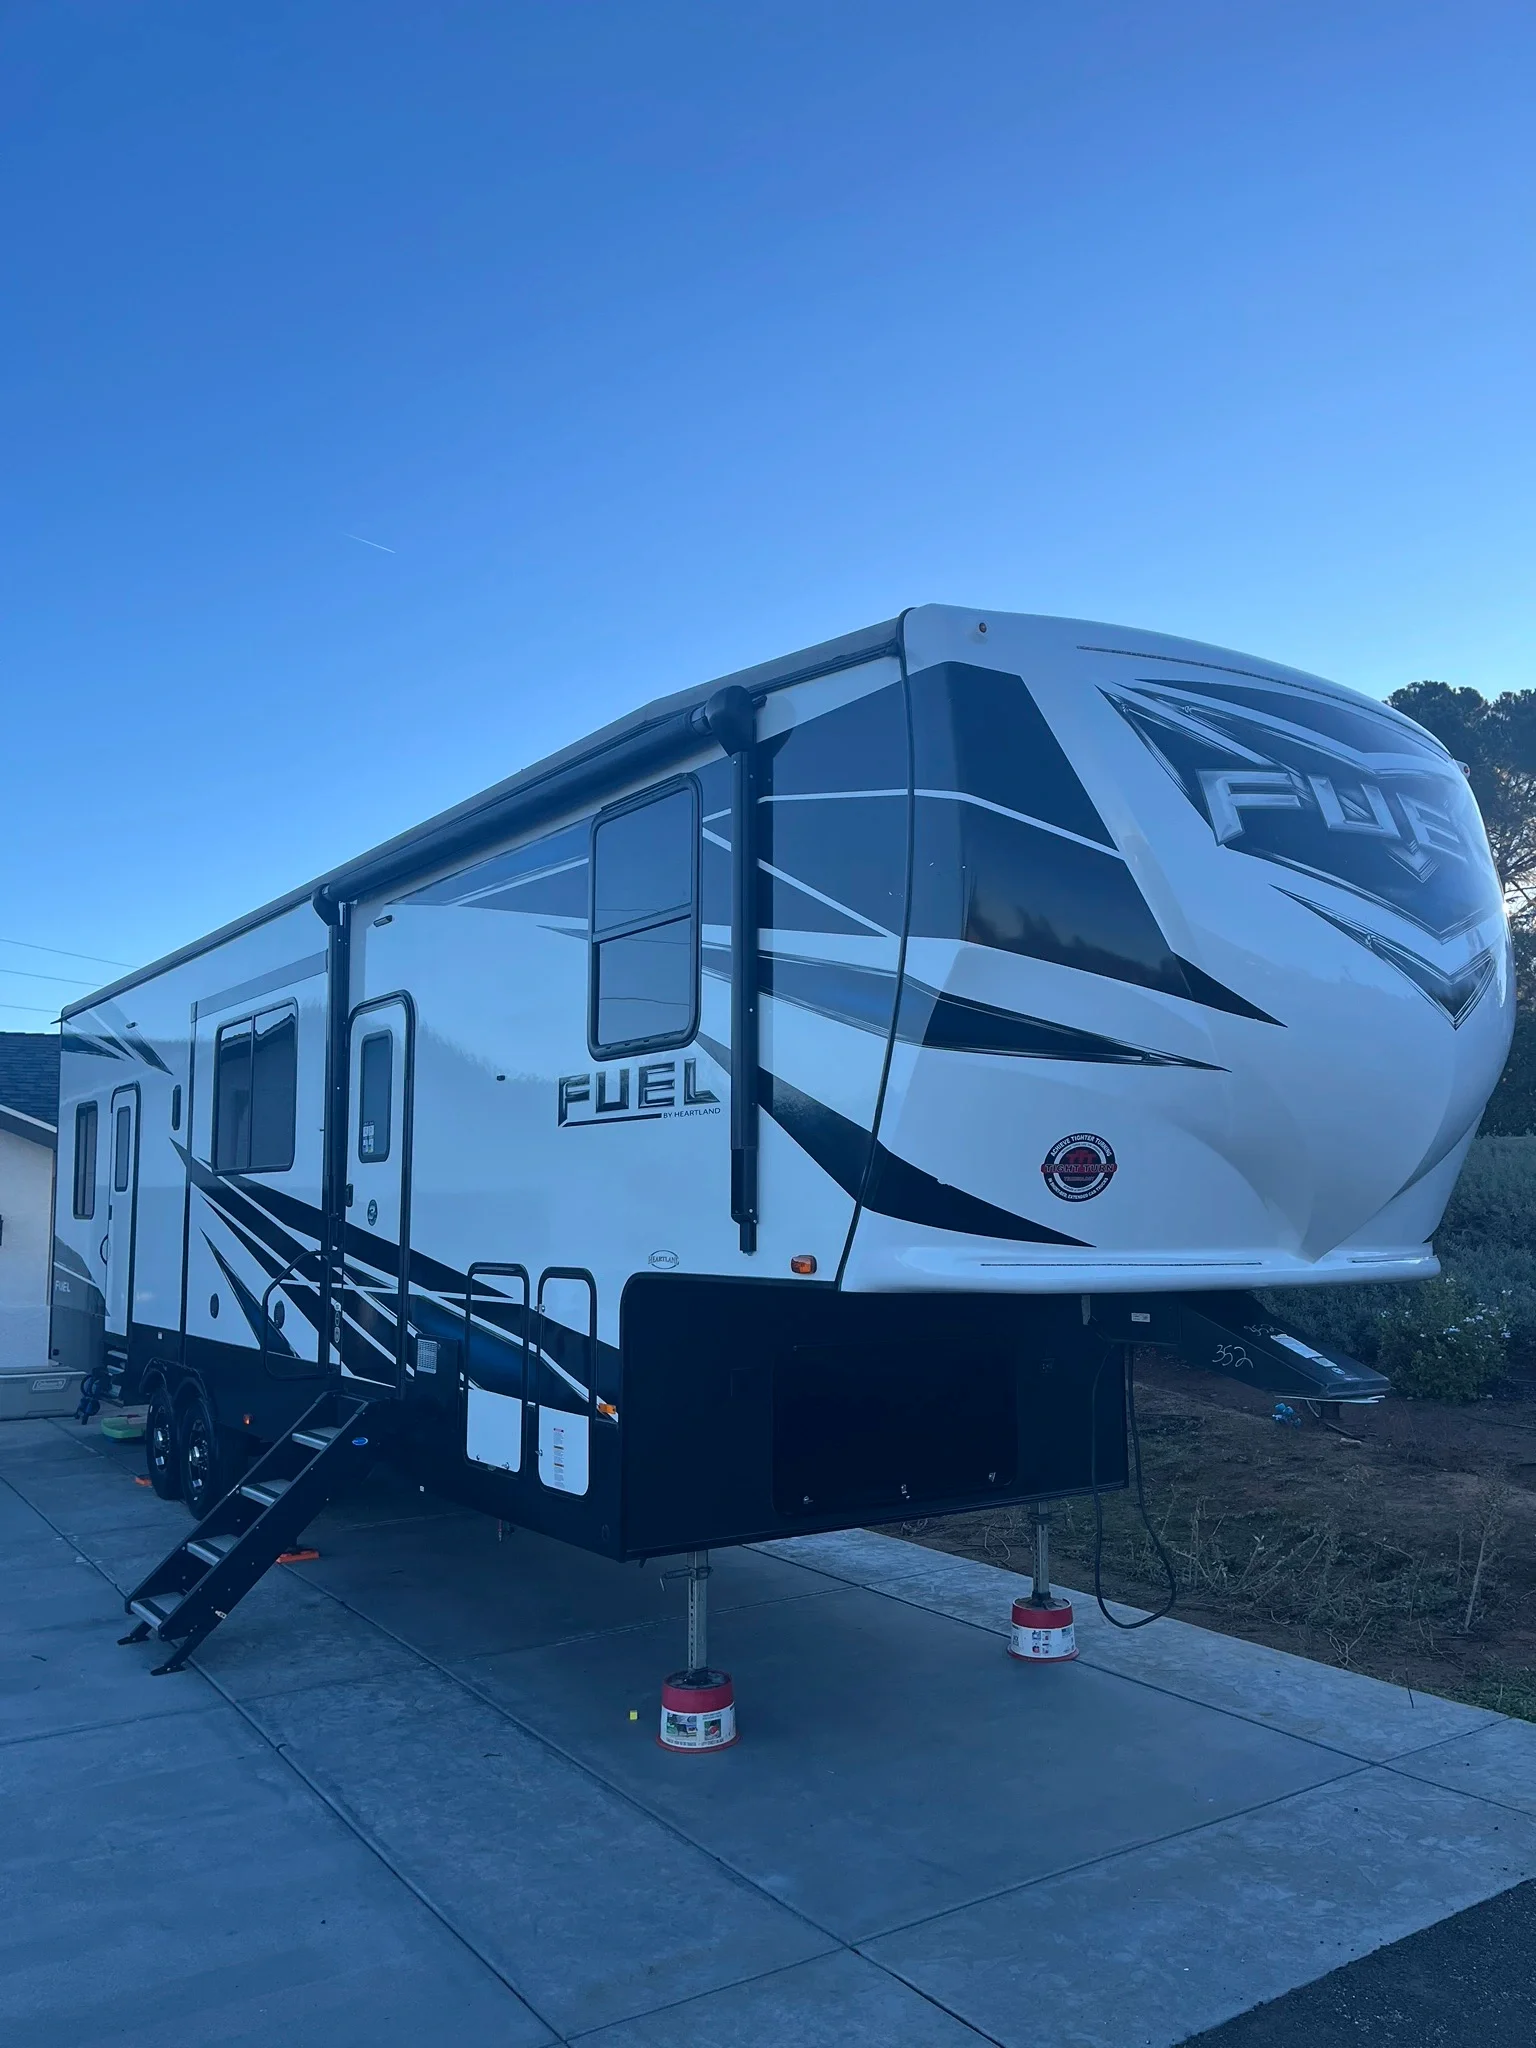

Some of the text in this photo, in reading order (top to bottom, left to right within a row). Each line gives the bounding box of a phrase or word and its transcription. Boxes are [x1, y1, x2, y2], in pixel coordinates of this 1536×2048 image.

[1195, 768, 1469, 865] FUE
[558, 1058, 721, 1127] FUEL
[674, 1107, 721, 1118] HEARTLAND
[1051, 1138, 1071, 1157] ACHIEVE
[1071, 1134, 1095, 1143] TIGHTER
[1095, 1137, 1112, 1157] TURNING
[1045, 1163, 1115, 1173] TIGHT TURN
[55, 1280, 71, 1293] FUEL
[1212, 1344, 1254, 1369] 352
